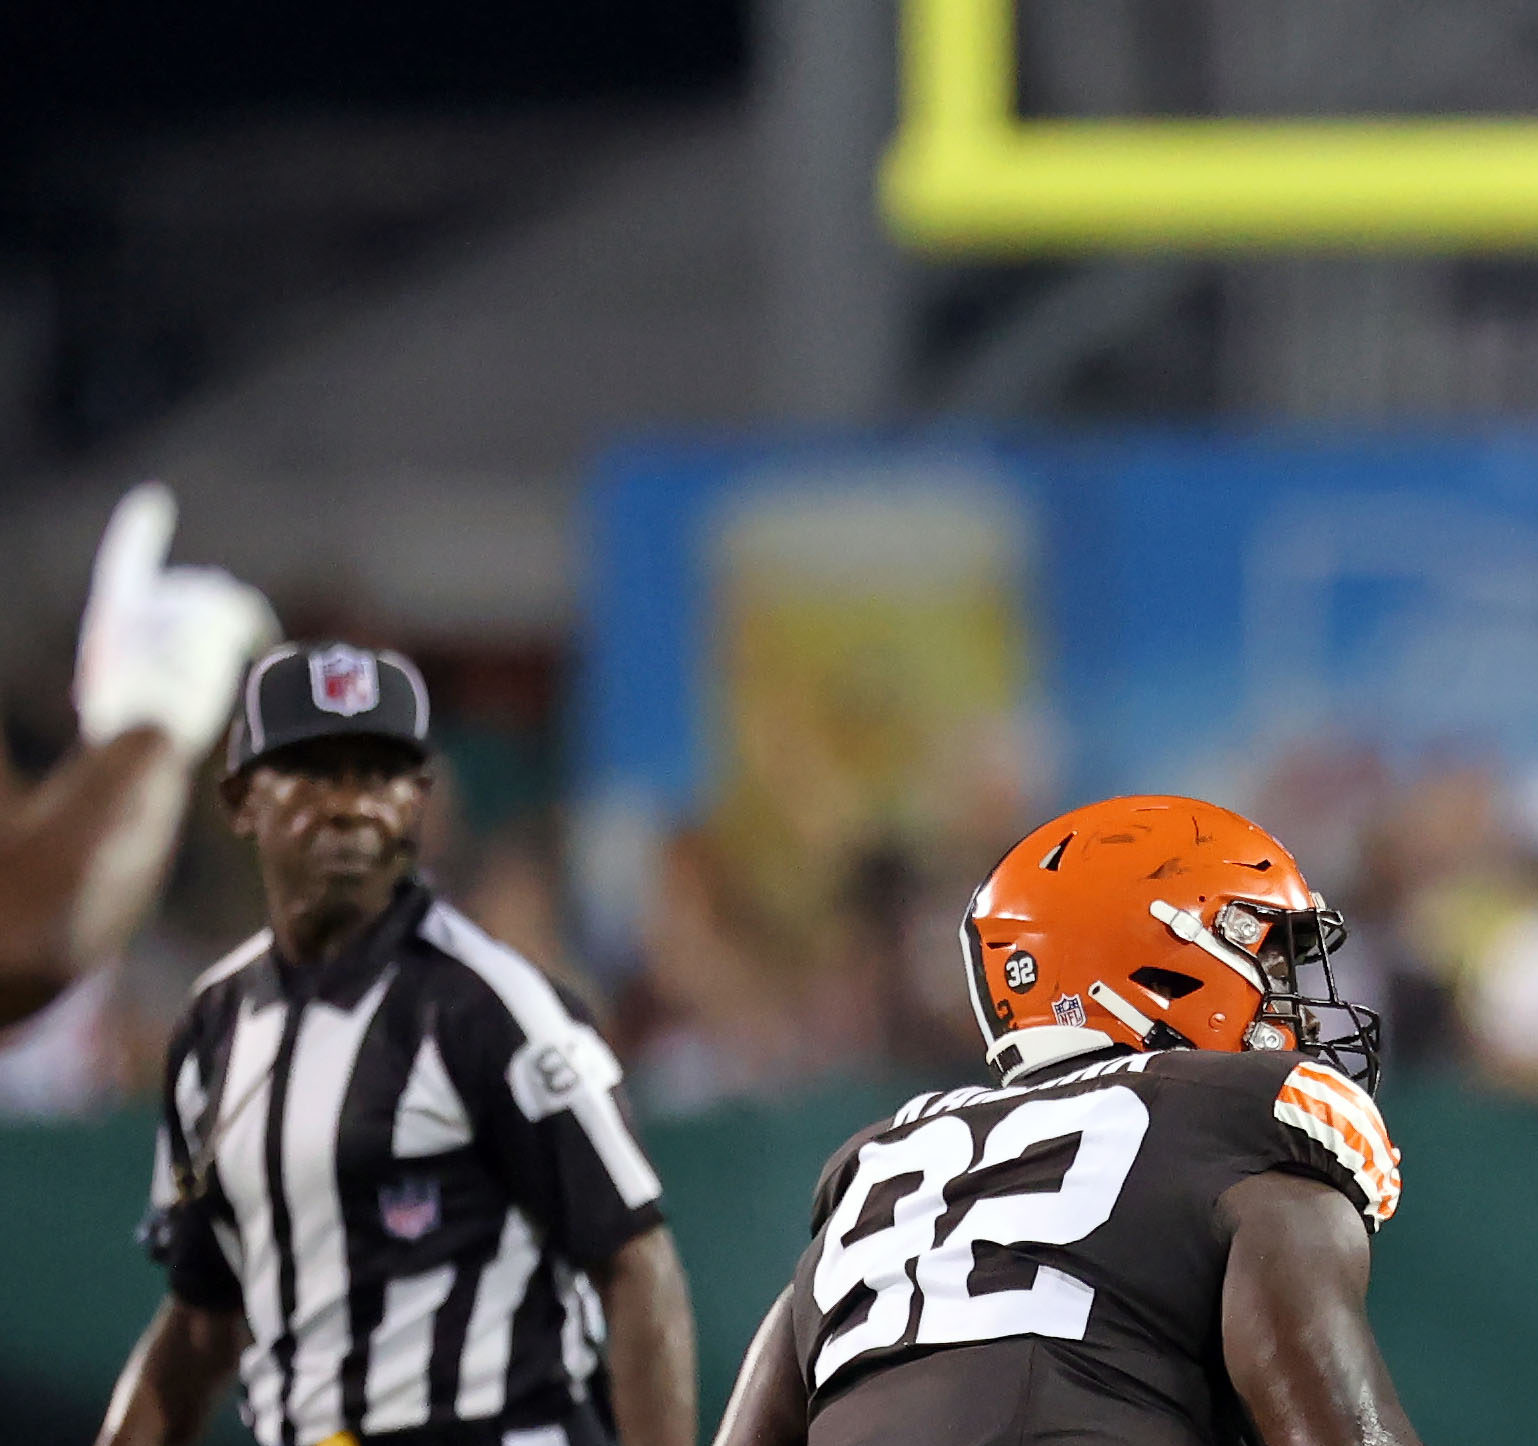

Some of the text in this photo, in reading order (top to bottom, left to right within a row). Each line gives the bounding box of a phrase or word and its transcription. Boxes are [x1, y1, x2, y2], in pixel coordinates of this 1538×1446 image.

[1006, 956, 1036, 989] 32
[1060, 1010, 1082, 1026] NFL
[813, 1084, 1150, 1388] 92
